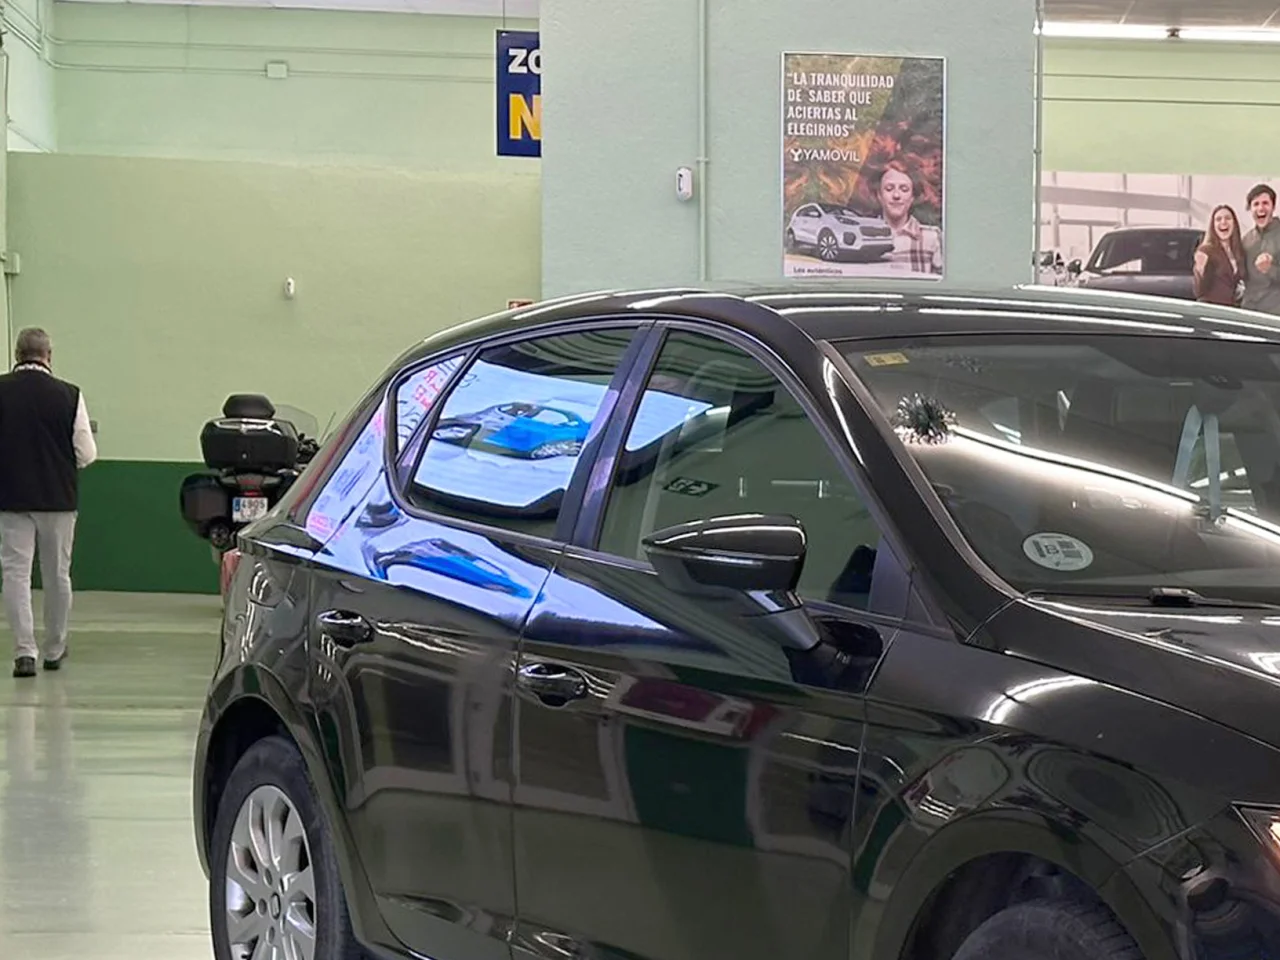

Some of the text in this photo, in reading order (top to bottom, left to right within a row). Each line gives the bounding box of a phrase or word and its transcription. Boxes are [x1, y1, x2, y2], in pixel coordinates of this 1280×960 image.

[810, 73, 895, 88] TRANQUILIDAD
[787, 89, 872, 105] DE SABER QUE
[787, 107, 858, 121] ACIERTAS AL
[804, 149, 861, 162] YAMOVIL
